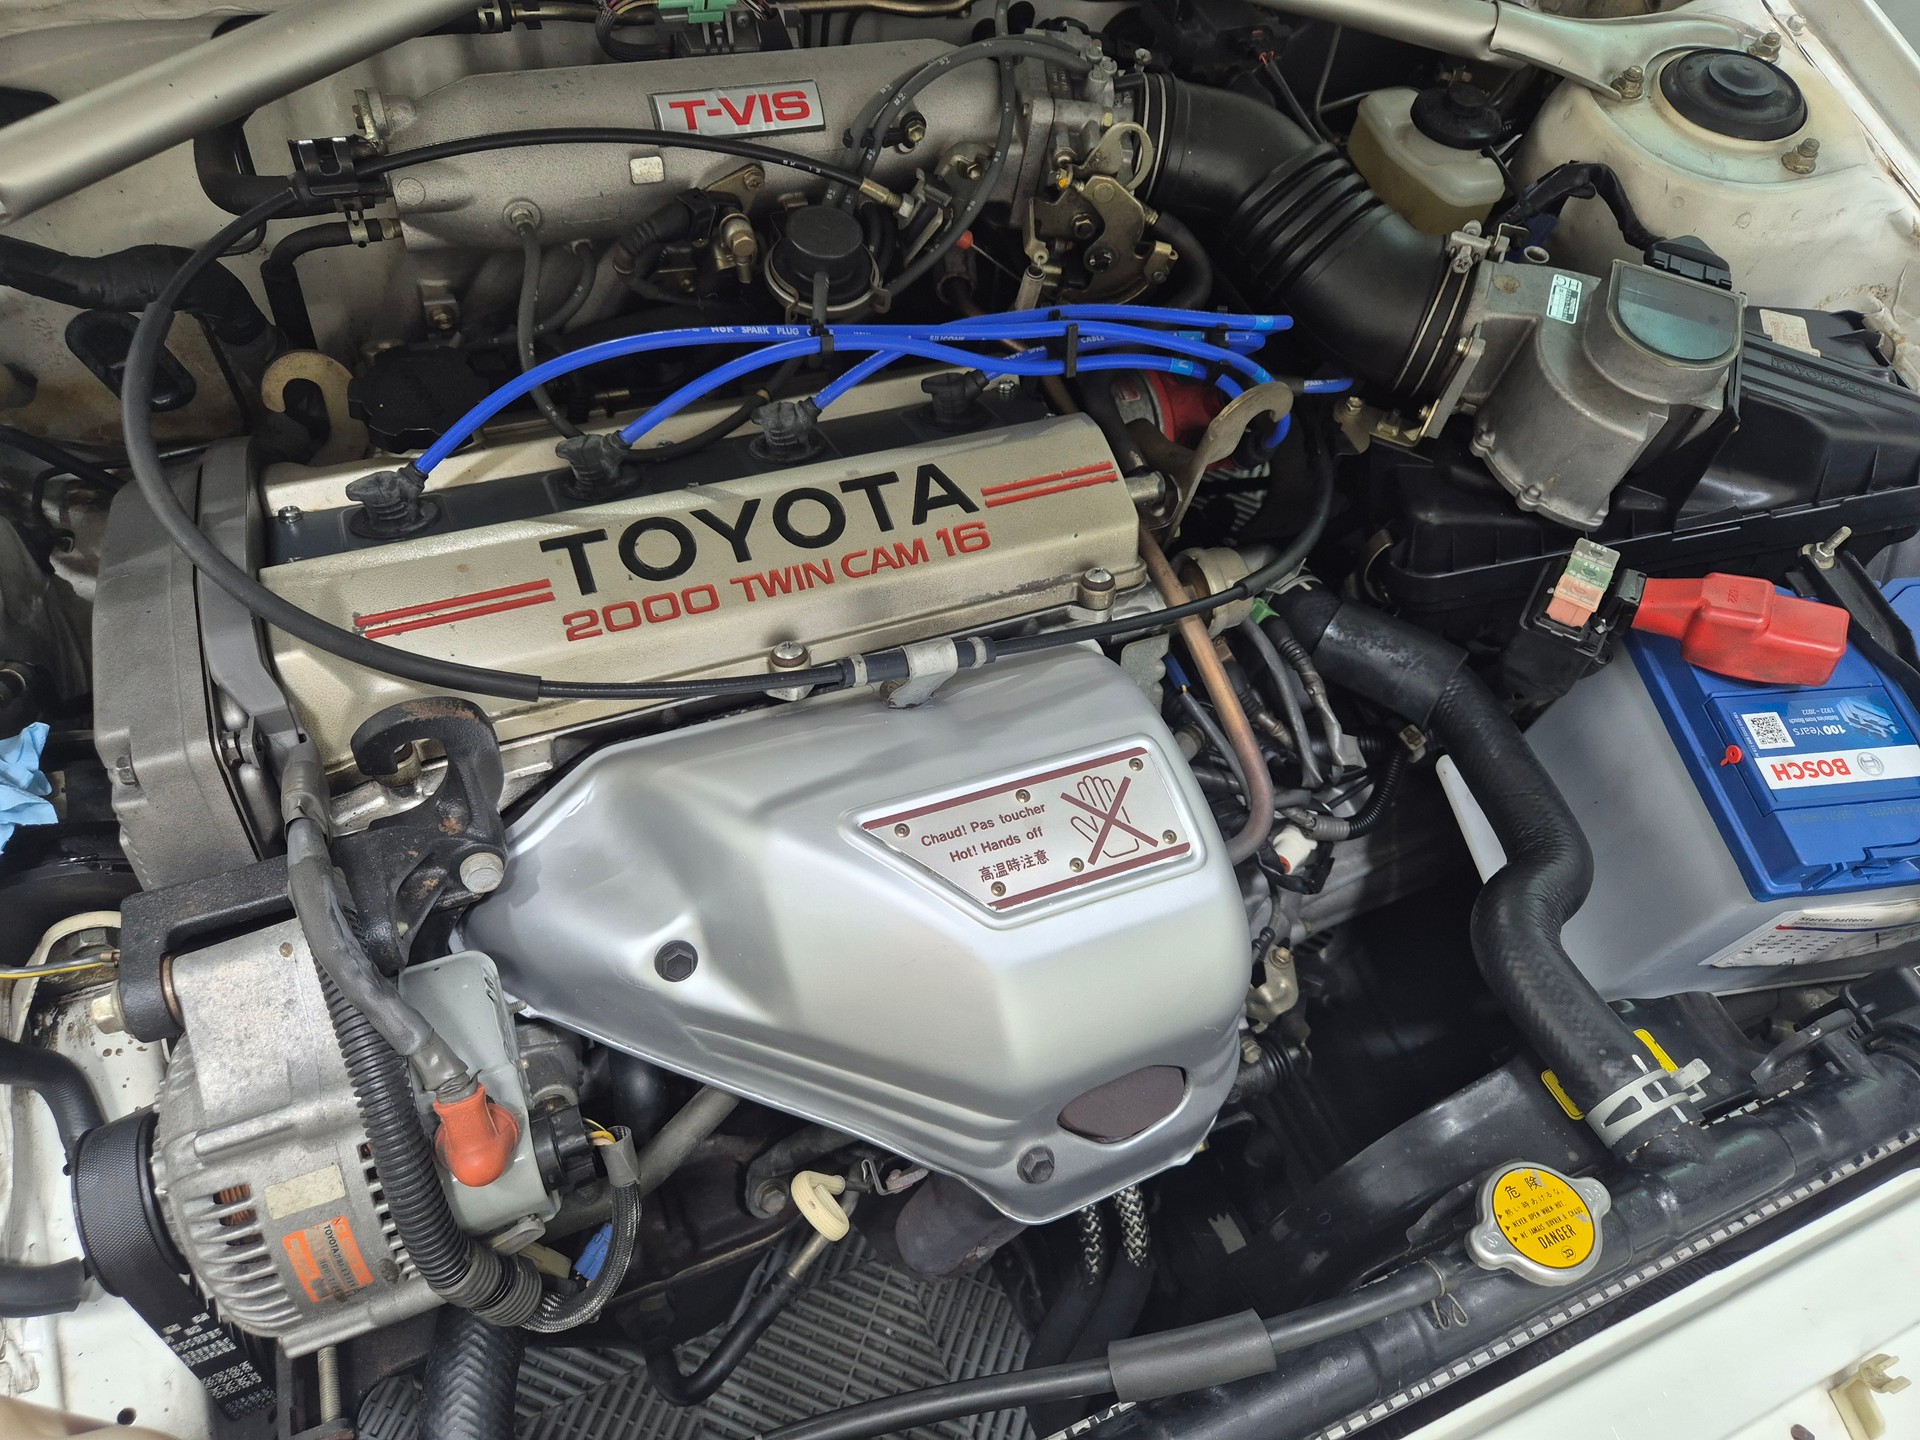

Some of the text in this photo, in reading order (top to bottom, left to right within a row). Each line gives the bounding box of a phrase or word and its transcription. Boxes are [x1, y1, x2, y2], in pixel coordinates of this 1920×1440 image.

[669, 90, 810, 130] T-VIS
[741, 326, 769, 335] SPARK
[776, 326, 799, 336] PLUG
[539, 463, 980, 596] TOYOTA
[562, 521, 991, 642] 2000 TWIN CAM 16
[1770, 758, 1851, 781] BOSCH
[921, 803, 1046, 847] Chaud! Pas toucher
[949, 826, 1044, 863] Hot! Hands off
[978, 849, 1050, 883] 高温時注意
[1528, 1211, 1541, 1223] OPEN
[1541, 1206, 1553, 1218] WHEN
[323, 1224, 339, 1254] TOYOTA
[1537, 1224, 1577, 1249] DANGER
